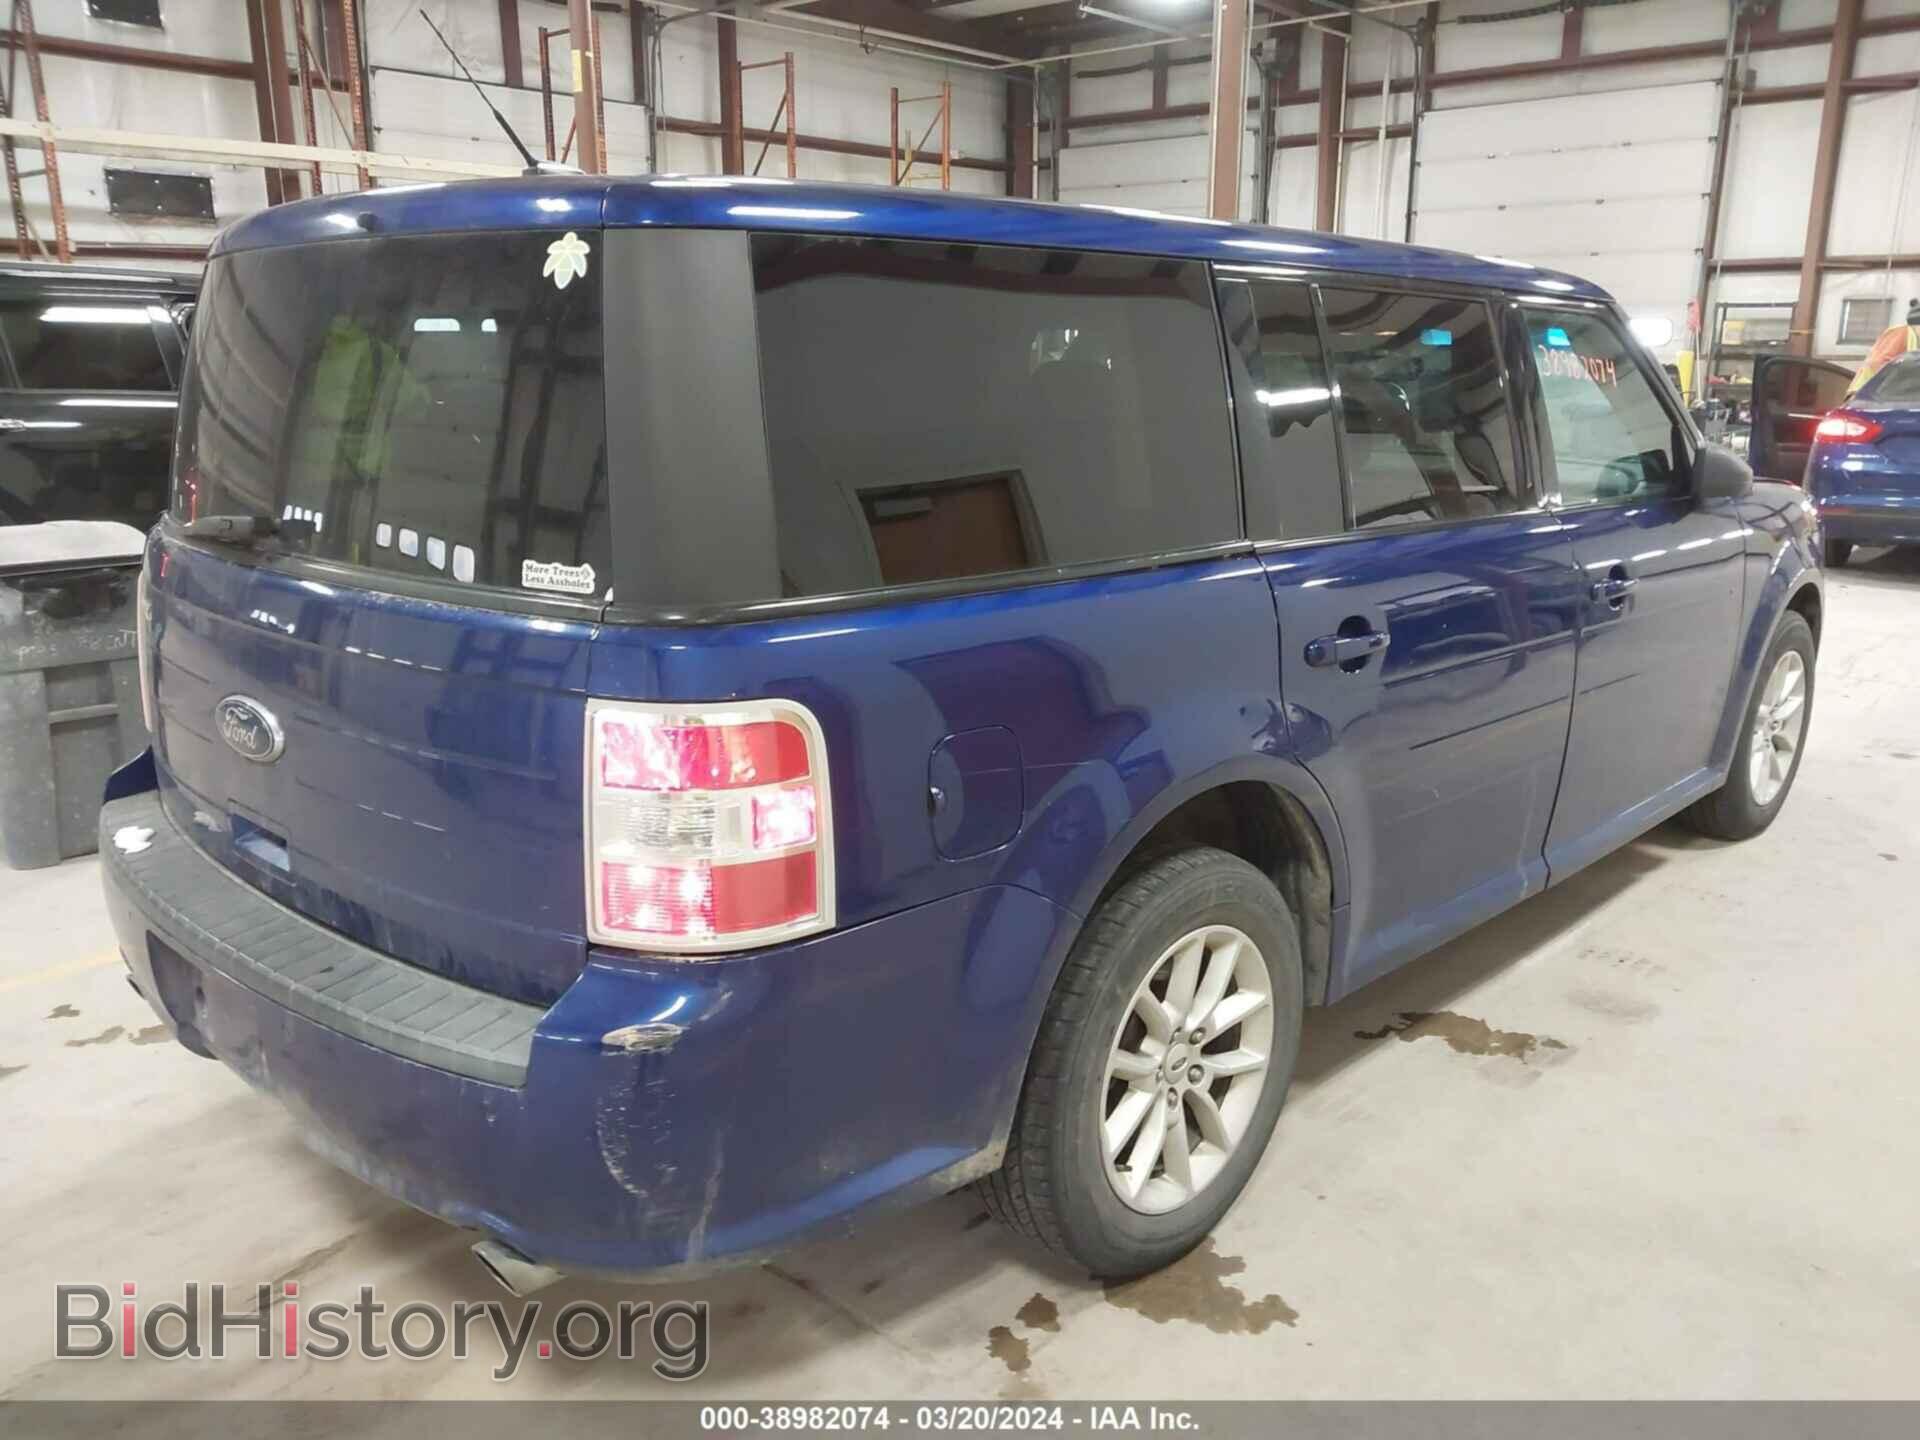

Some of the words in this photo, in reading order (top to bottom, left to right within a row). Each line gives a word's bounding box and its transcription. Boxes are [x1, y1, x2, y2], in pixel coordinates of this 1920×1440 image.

[525, 563, 550, 574] More
[551, 565, 580, 577] Trees
[525, 573, 545, 584] Less
[546, 576, 591, 589] Assholes
[223, 706, 257, 751] Ford
